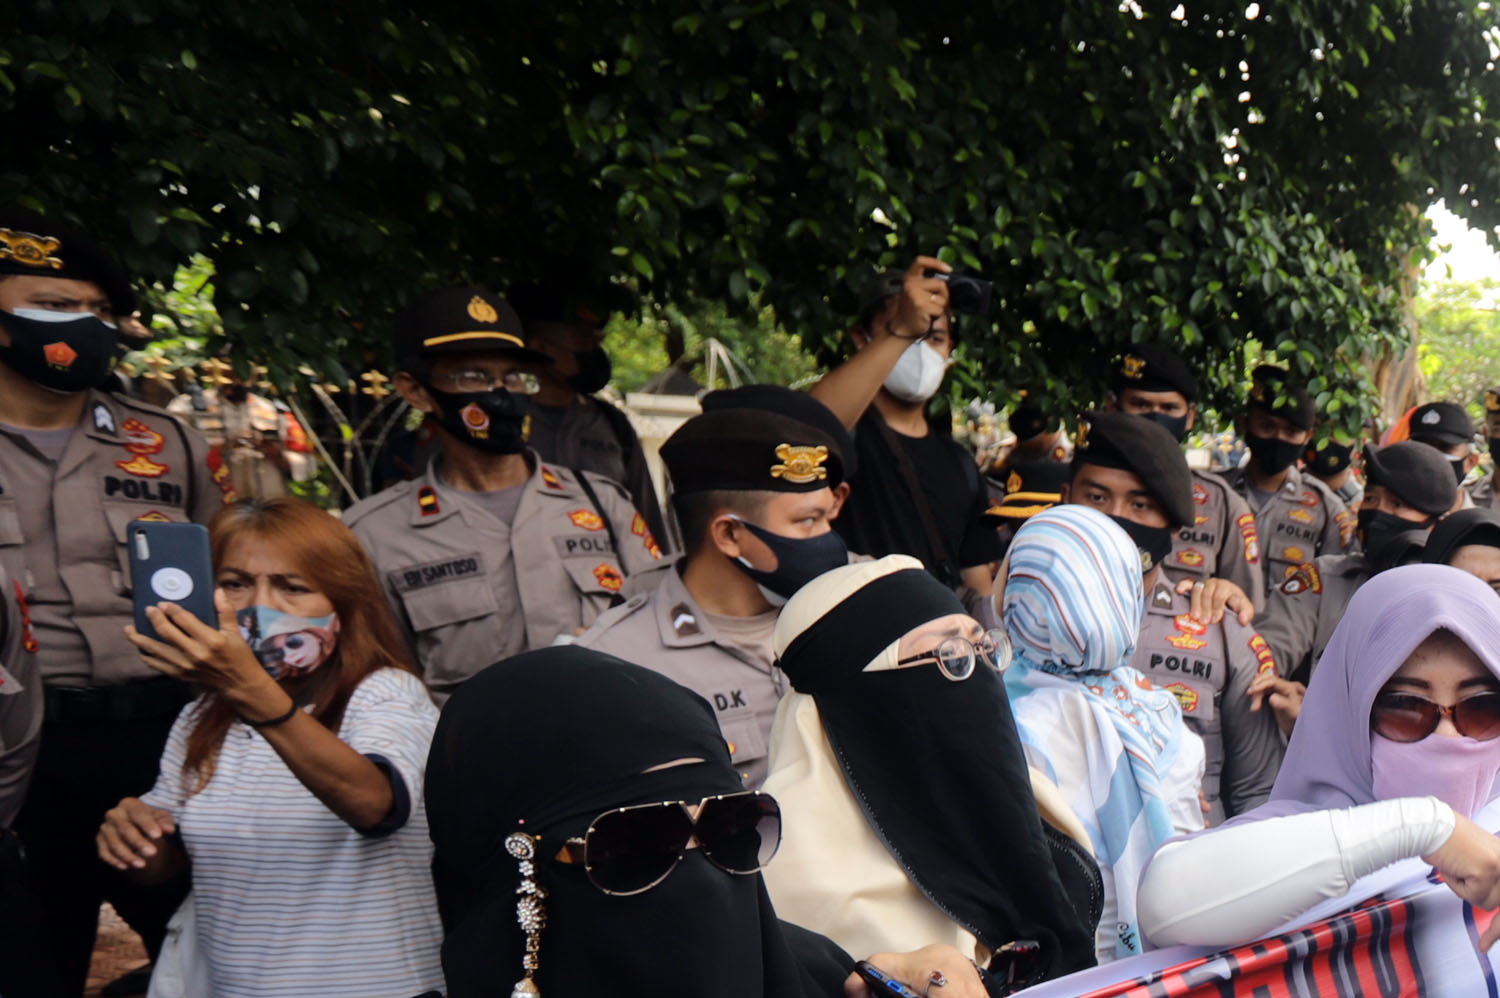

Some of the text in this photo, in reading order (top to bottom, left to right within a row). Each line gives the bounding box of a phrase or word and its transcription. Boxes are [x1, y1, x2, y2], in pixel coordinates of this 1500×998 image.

[104, 476, 183, 503] POLRI
[1180, 529, 1215, 546] OLRI
[1276, 522, 1316, 542] POLRI
[1151, 653, 1213, 680] POLRI
[713, 690, 747, 711] D.K
